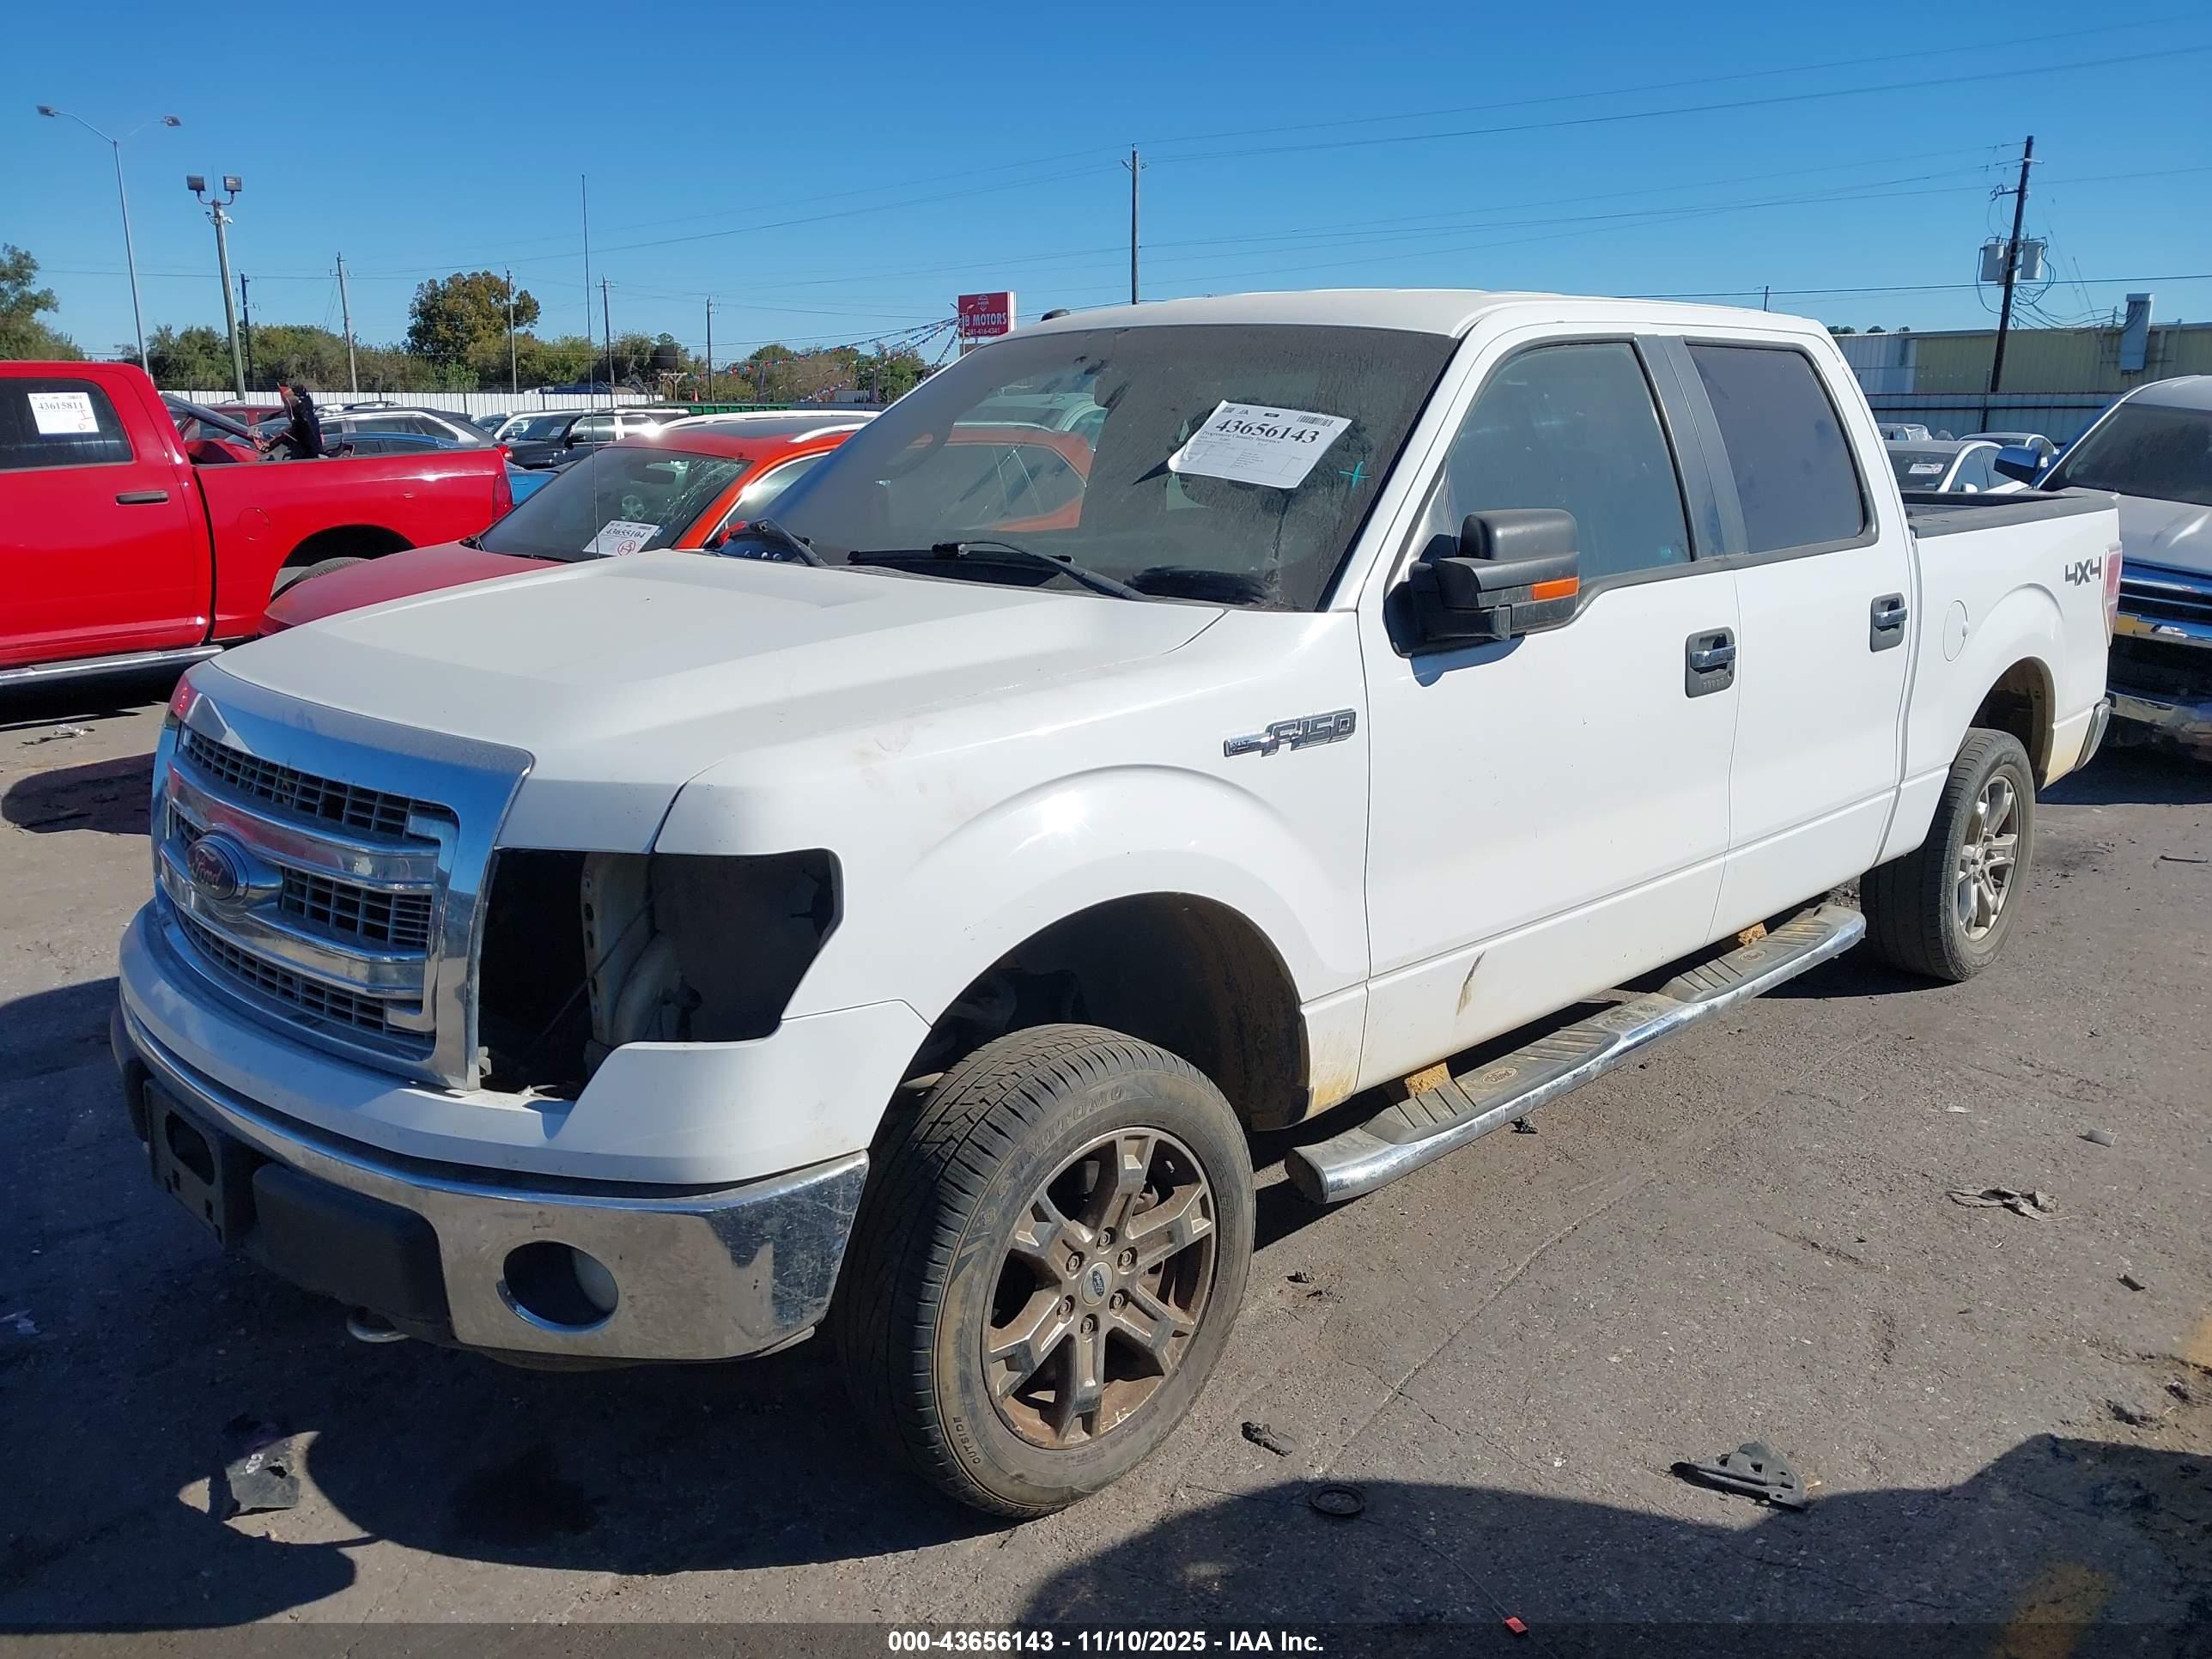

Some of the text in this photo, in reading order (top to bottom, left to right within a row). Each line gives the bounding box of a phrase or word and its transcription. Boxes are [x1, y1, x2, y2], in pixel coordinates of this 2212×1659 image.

[972, 312, 1007, 326] MOTORS
[38, 401, 84, 410] 43615811
[1215, 419, 1320, 444] 43656143
